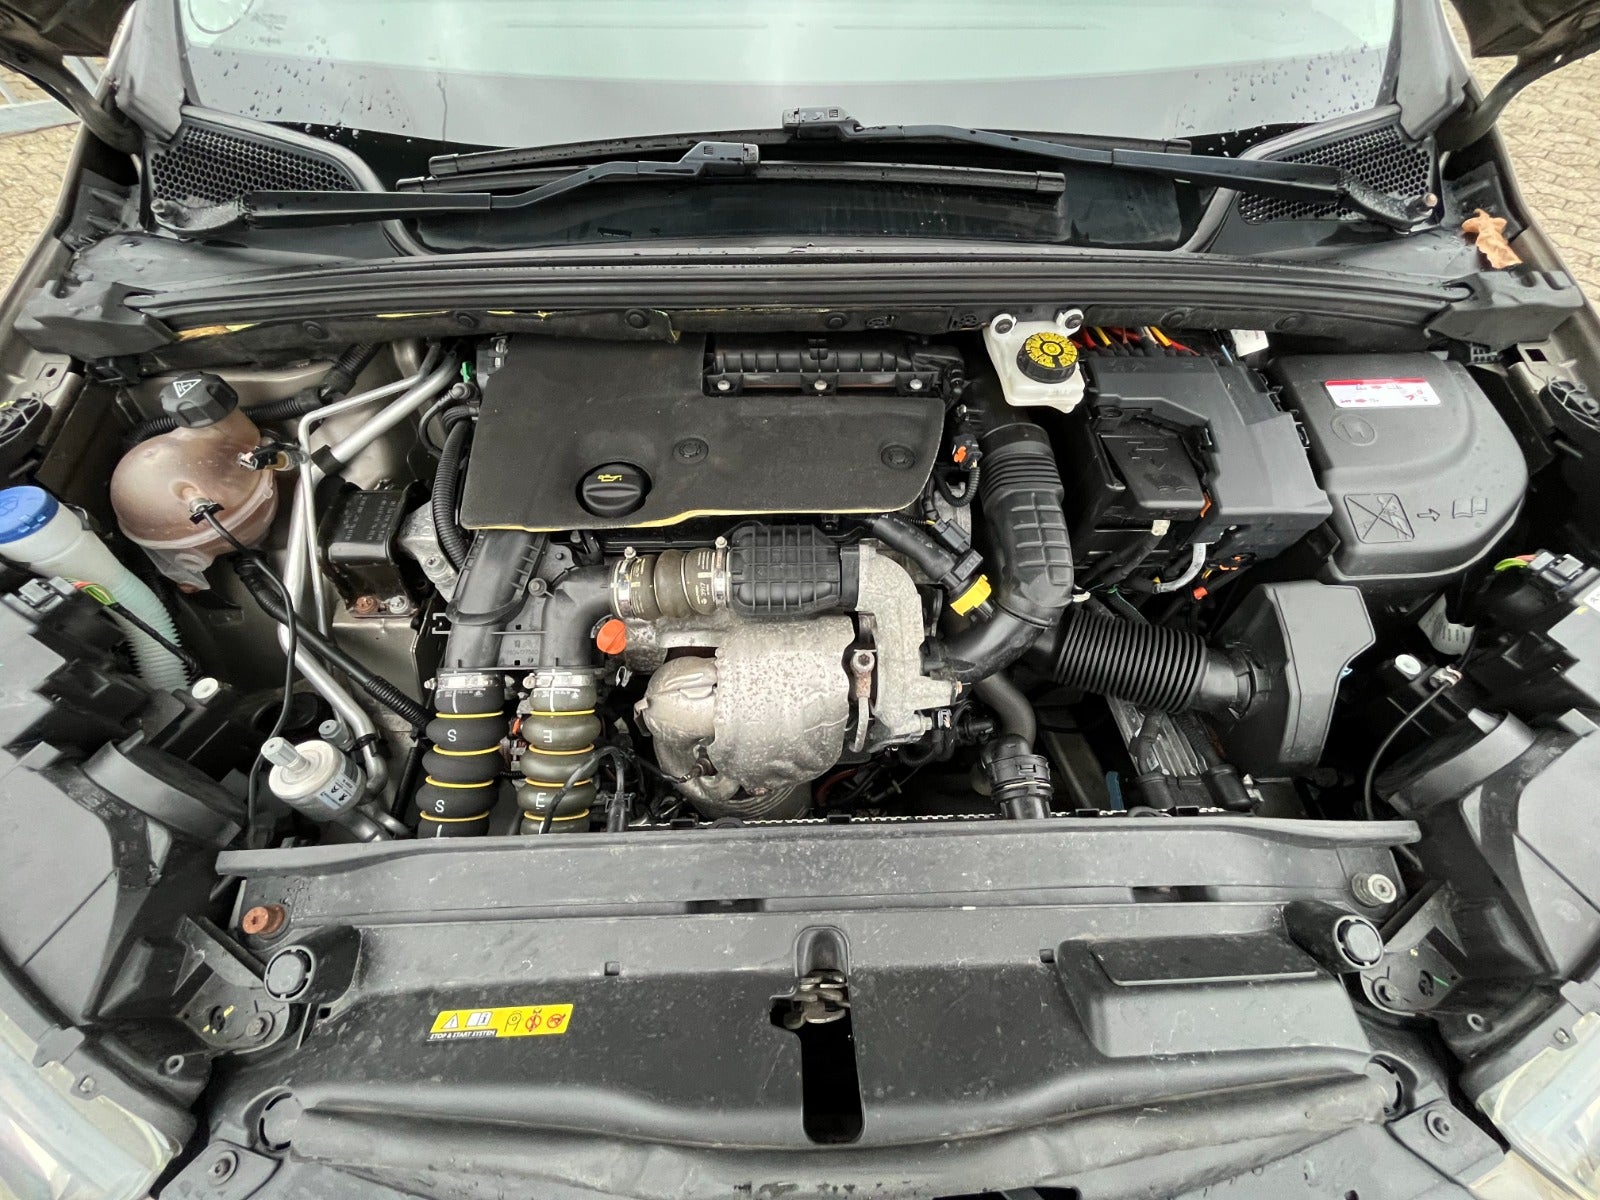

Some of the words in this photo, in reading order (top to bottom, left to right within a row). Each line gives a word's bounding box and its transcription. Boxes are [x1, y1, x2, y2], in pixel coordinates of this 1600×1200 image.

[447, 728, 457, 742] S
[434, 799, 445, 813] S
[430, 1032, 447, 1040] STOP
